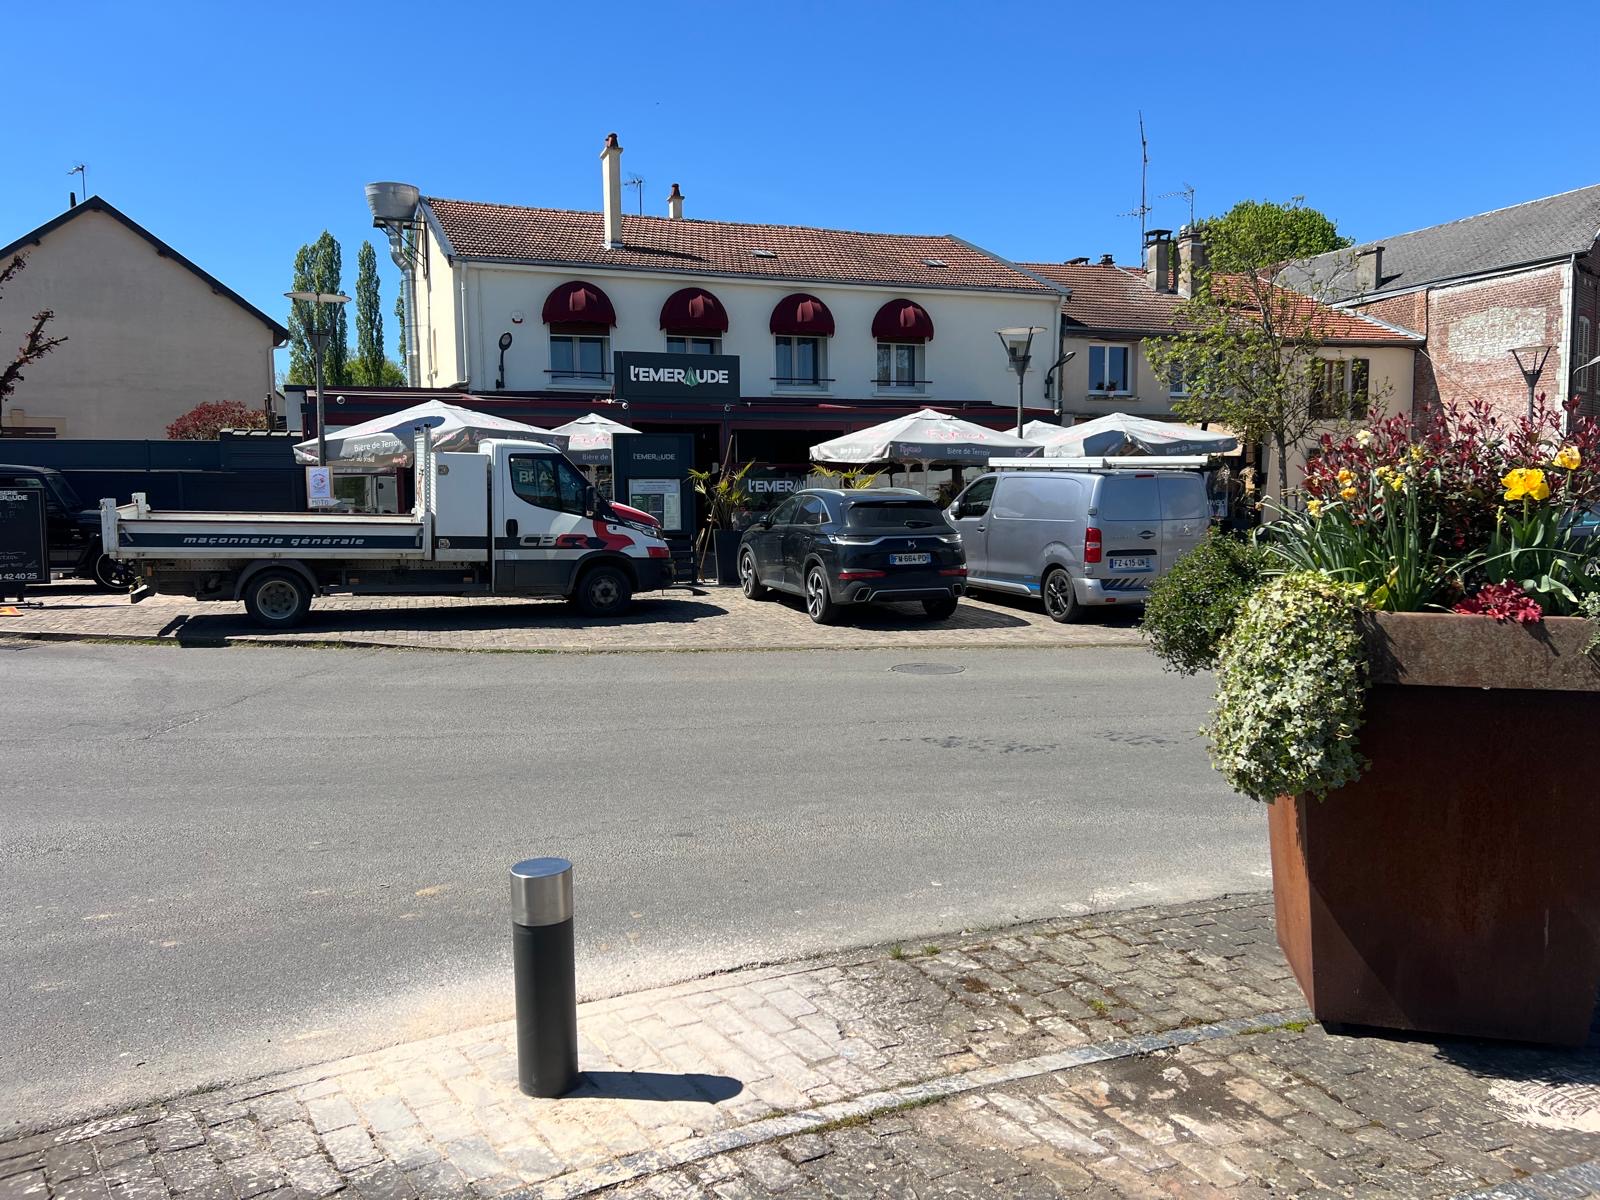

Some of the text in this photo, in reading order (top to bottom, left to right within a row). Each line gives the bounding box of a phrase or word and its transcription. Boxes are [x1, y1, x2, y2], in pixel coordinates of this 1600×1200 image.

[372, 441, 380, 449] de
[946, 447, 991, 456] Bière de Terroir
[183, 536, 365, 547] maçonnerie générale
[27, 572, 38, 580] 25
